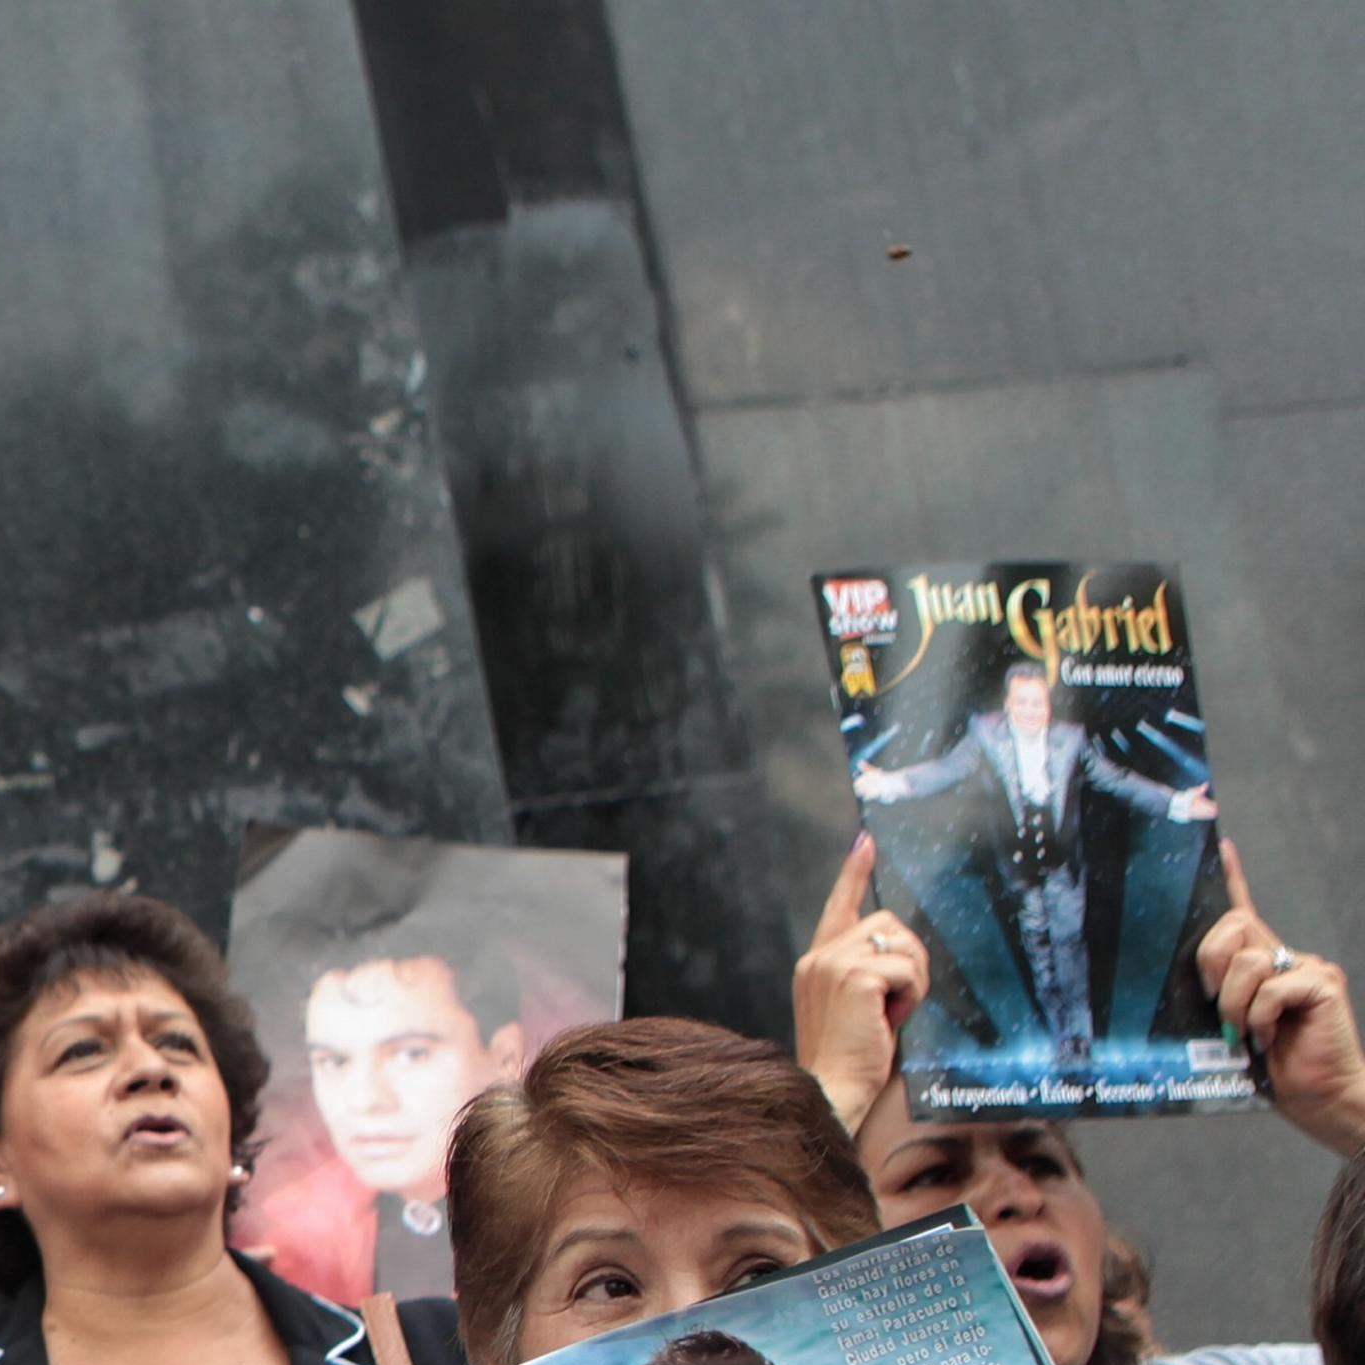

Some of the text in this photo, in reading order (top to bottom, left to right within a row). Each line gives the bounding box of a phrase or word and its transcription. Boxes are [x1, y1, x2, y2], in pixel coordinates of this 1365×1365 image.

[822, 580, 889, 614] VIP
[1005, 569, 1174, 688] Gabriel
[812, 1267, 840, 1284] Los
[817, 1244, 955, 1300] Garibaldi están de
[861, 1283, 889, 1302] hay
[892, 1267, 937, 1290] flores
[941, 1259, 961, 1273] en
[831, 1274, 966, 1333] su estrella de la
[961, 1291, 972, 1306] y
[901, 1319, 950, 1347] Juárez
[934, 1336, 949, 1353] él
[953, 1322, 986, 1346] dejó
